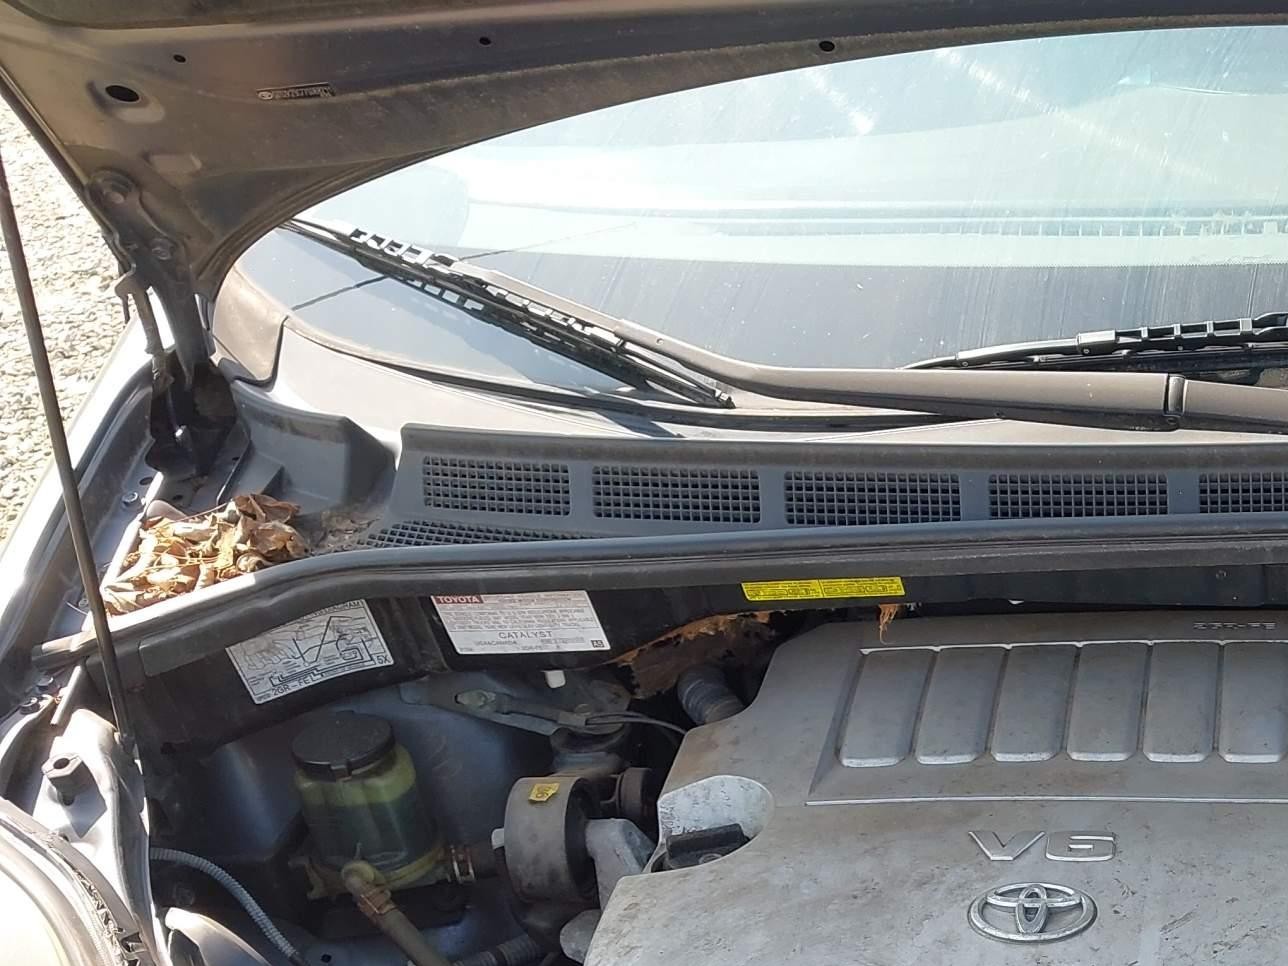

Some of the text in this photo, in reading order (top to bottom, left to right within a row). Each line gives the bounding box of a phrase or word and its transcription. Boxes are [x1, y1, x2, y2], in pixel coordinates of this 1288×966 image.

[438, 595, 480, 604] TOYOTA
[498, 631, 553, 639] CATALYST
[377, 655, 392, 665] 5X
[968, 831, 1117, 862] V6
